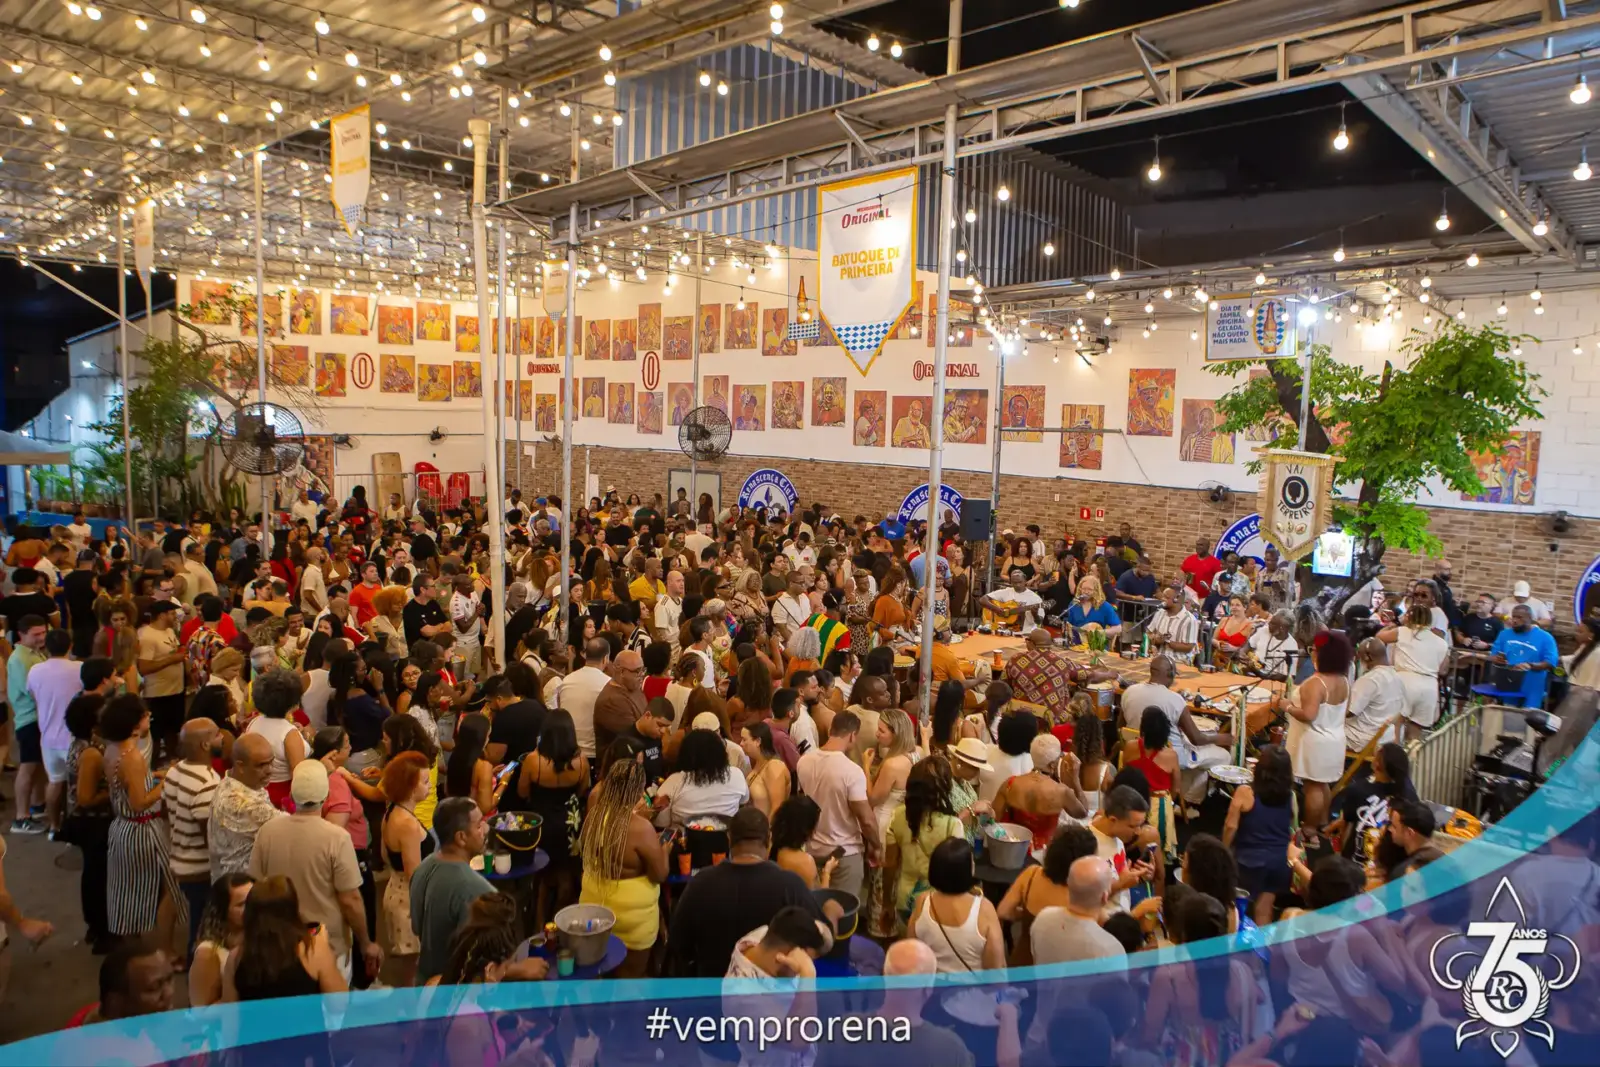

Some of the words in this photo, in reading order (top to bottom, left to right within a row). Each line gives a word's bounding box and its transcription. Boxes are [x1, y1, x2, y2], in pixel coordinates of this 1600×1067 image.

[841, 208, 892, 228] ORIGINL
[832, 248, 884, 267] BATUQUE
[840, 261, 893, 280] PRIMEIRA
[912, 360, 980, 381] ORINAL
[1286, 464, 1304, 475] VAI
[1277, 500, 1315, 520] TERREIRO
